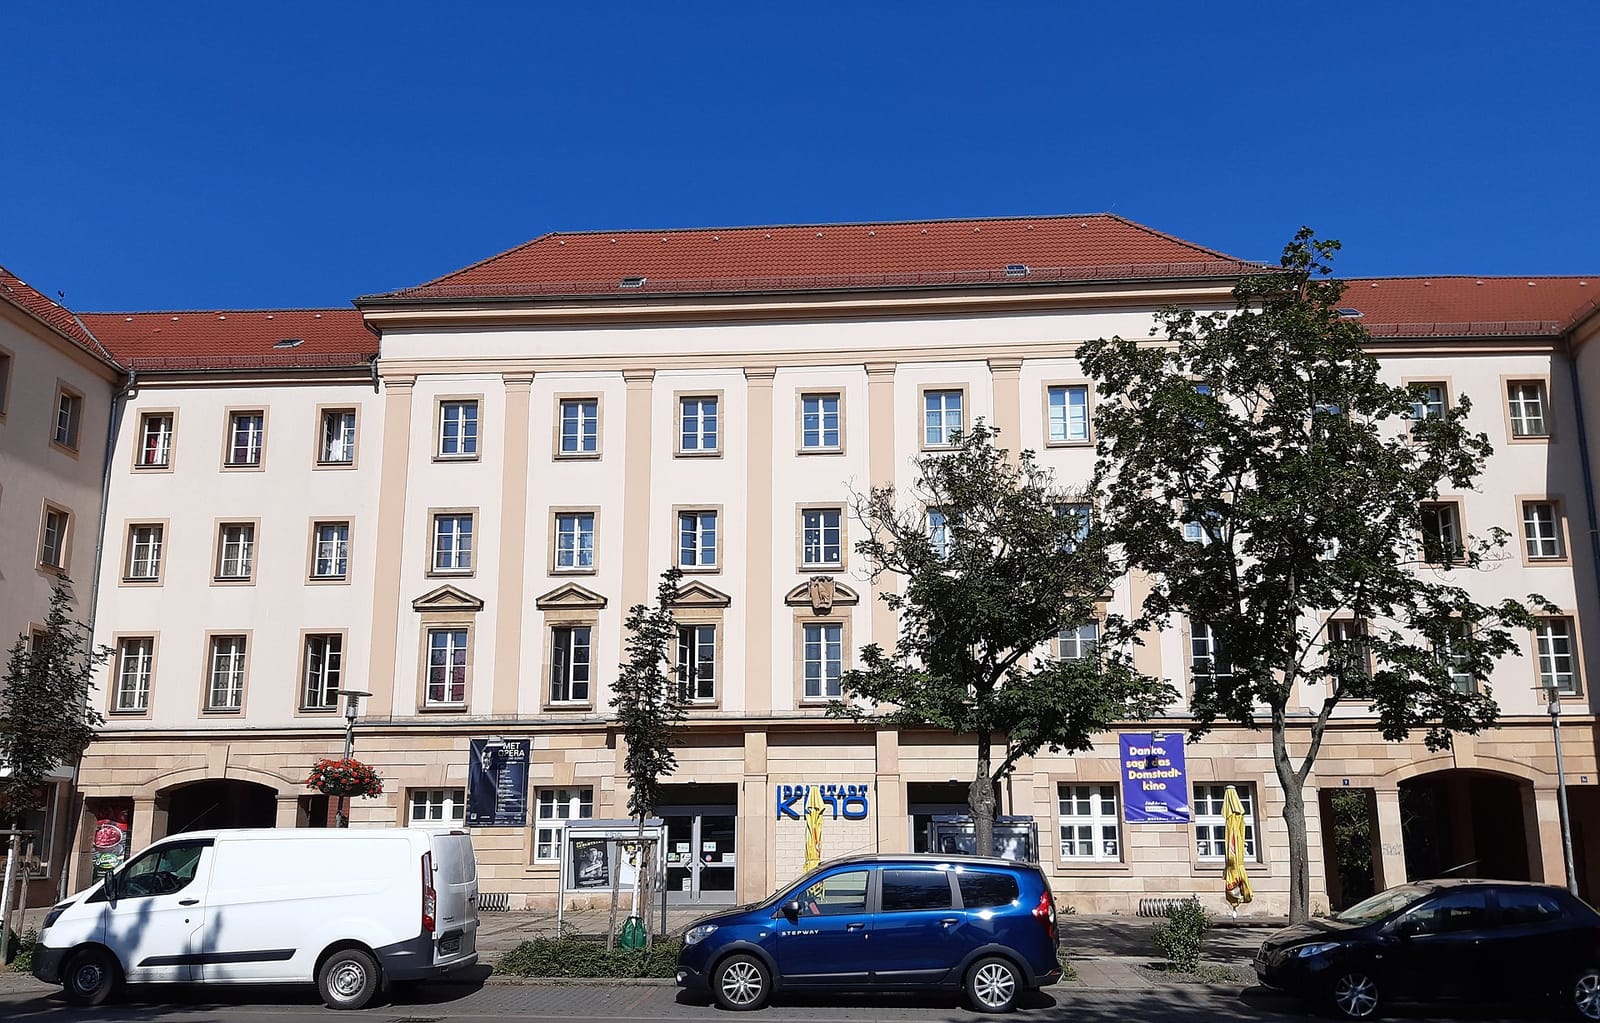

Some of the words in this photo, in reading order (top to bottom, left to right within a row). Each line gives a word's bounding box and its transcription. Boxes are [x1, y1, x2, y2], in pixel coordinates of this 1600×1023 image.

[1129, 746, 1166, 755] Danke,
[1126, 759, 1148, 769] sagt
[1152, 758, 1170, 766] das
[1128, 768, 1182, 780] Domstadt-
[1143, 781, 1166, 790] kino
